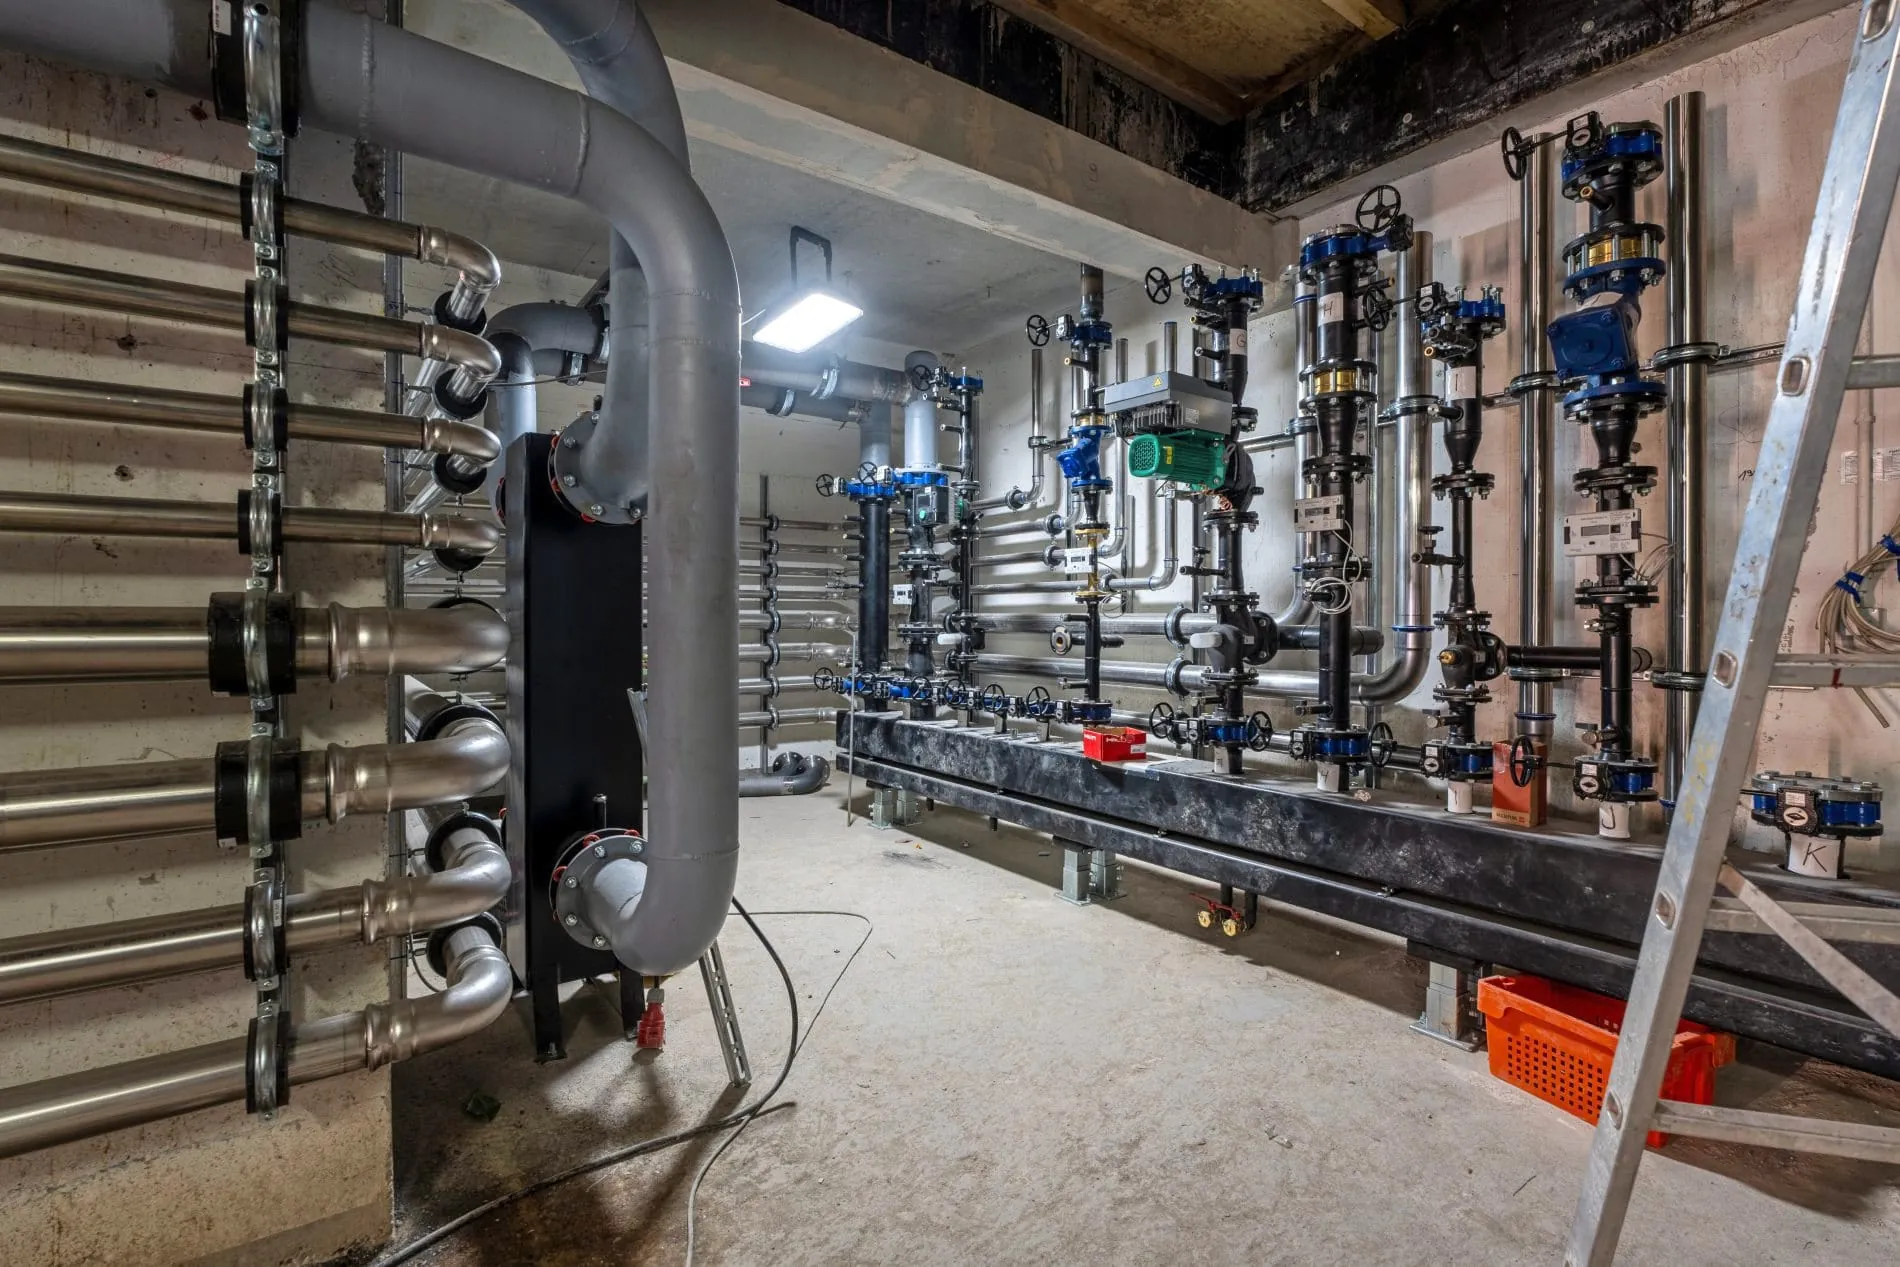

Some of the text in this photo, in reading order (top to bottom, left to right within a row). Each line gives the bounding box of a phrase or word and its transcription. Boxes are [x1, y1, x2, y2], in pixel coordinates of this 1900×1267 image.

[1322, 300, 1334, 317] H
[1602, 804, 1616, 830] J
[1802, 842, 1828, 873] K
